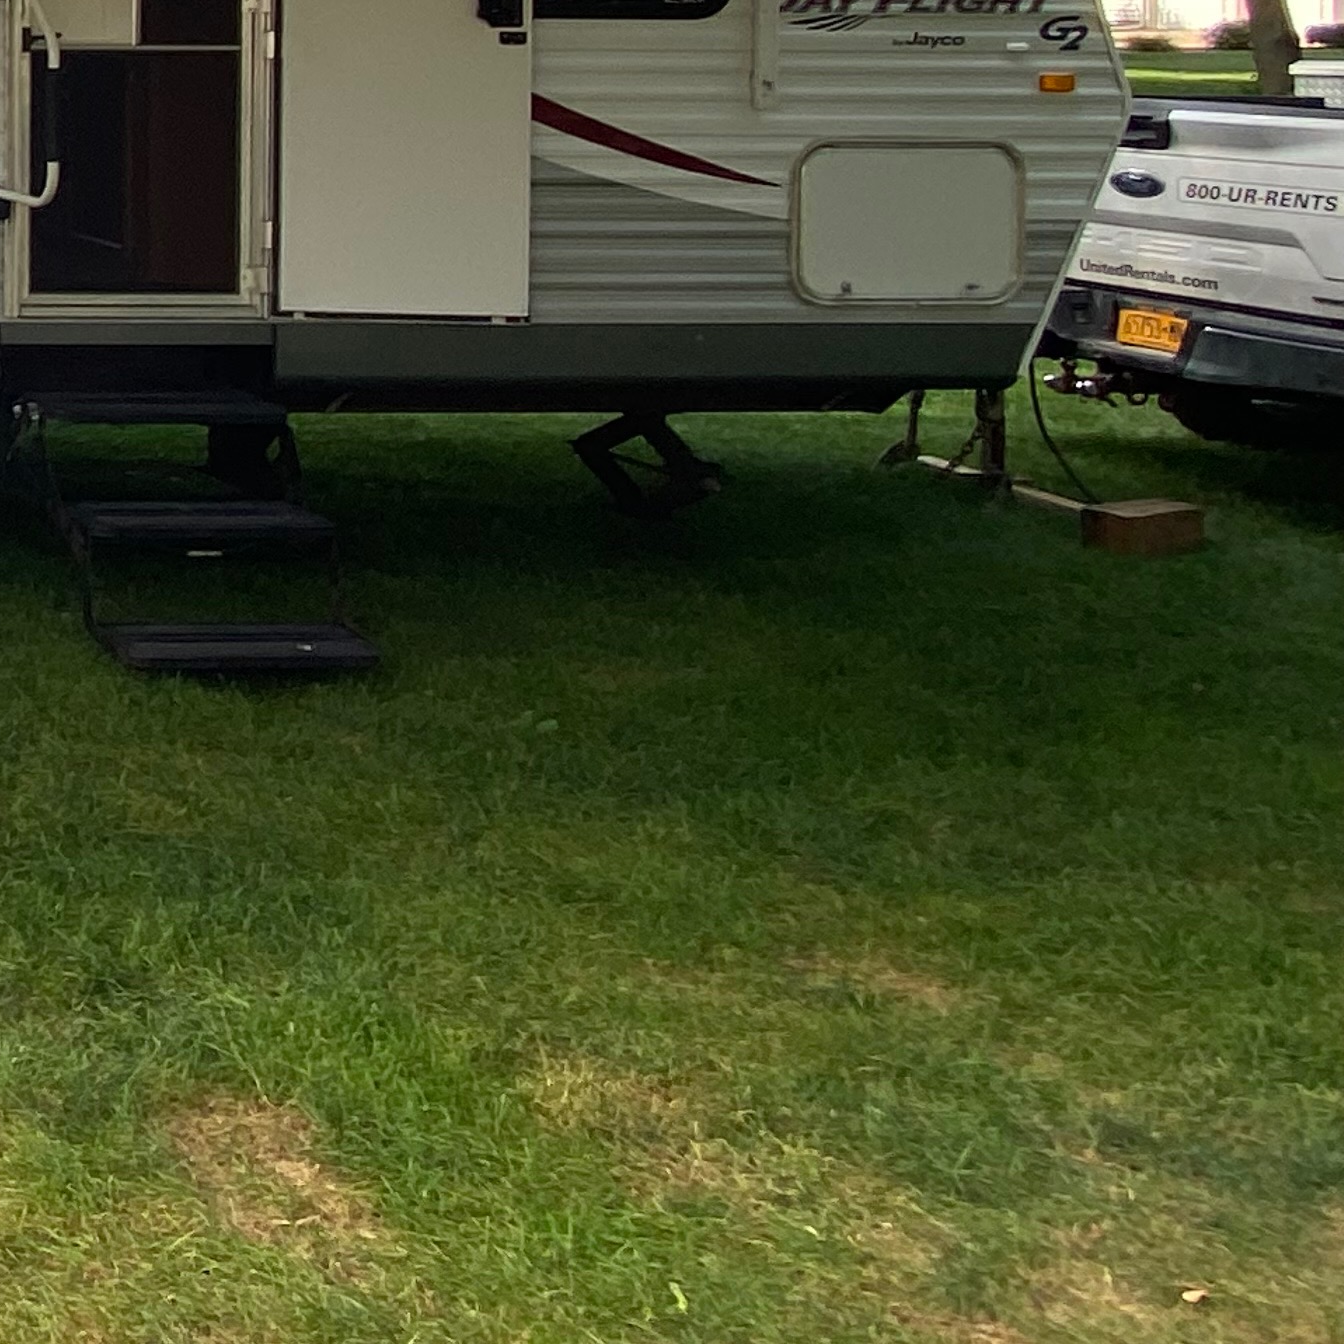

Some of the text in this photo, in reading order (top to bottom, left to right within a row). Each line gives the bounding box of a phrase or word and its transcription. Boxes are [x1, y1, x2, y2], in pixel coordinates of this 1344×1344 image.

[910, 32, 966, 49] Jayco
[1039, 16, 1089, 51] G2
[1185, 183, 1339, 212] 800-UR-RENTS
[1079, 258, 1219, 290] UnitedRentals.com
